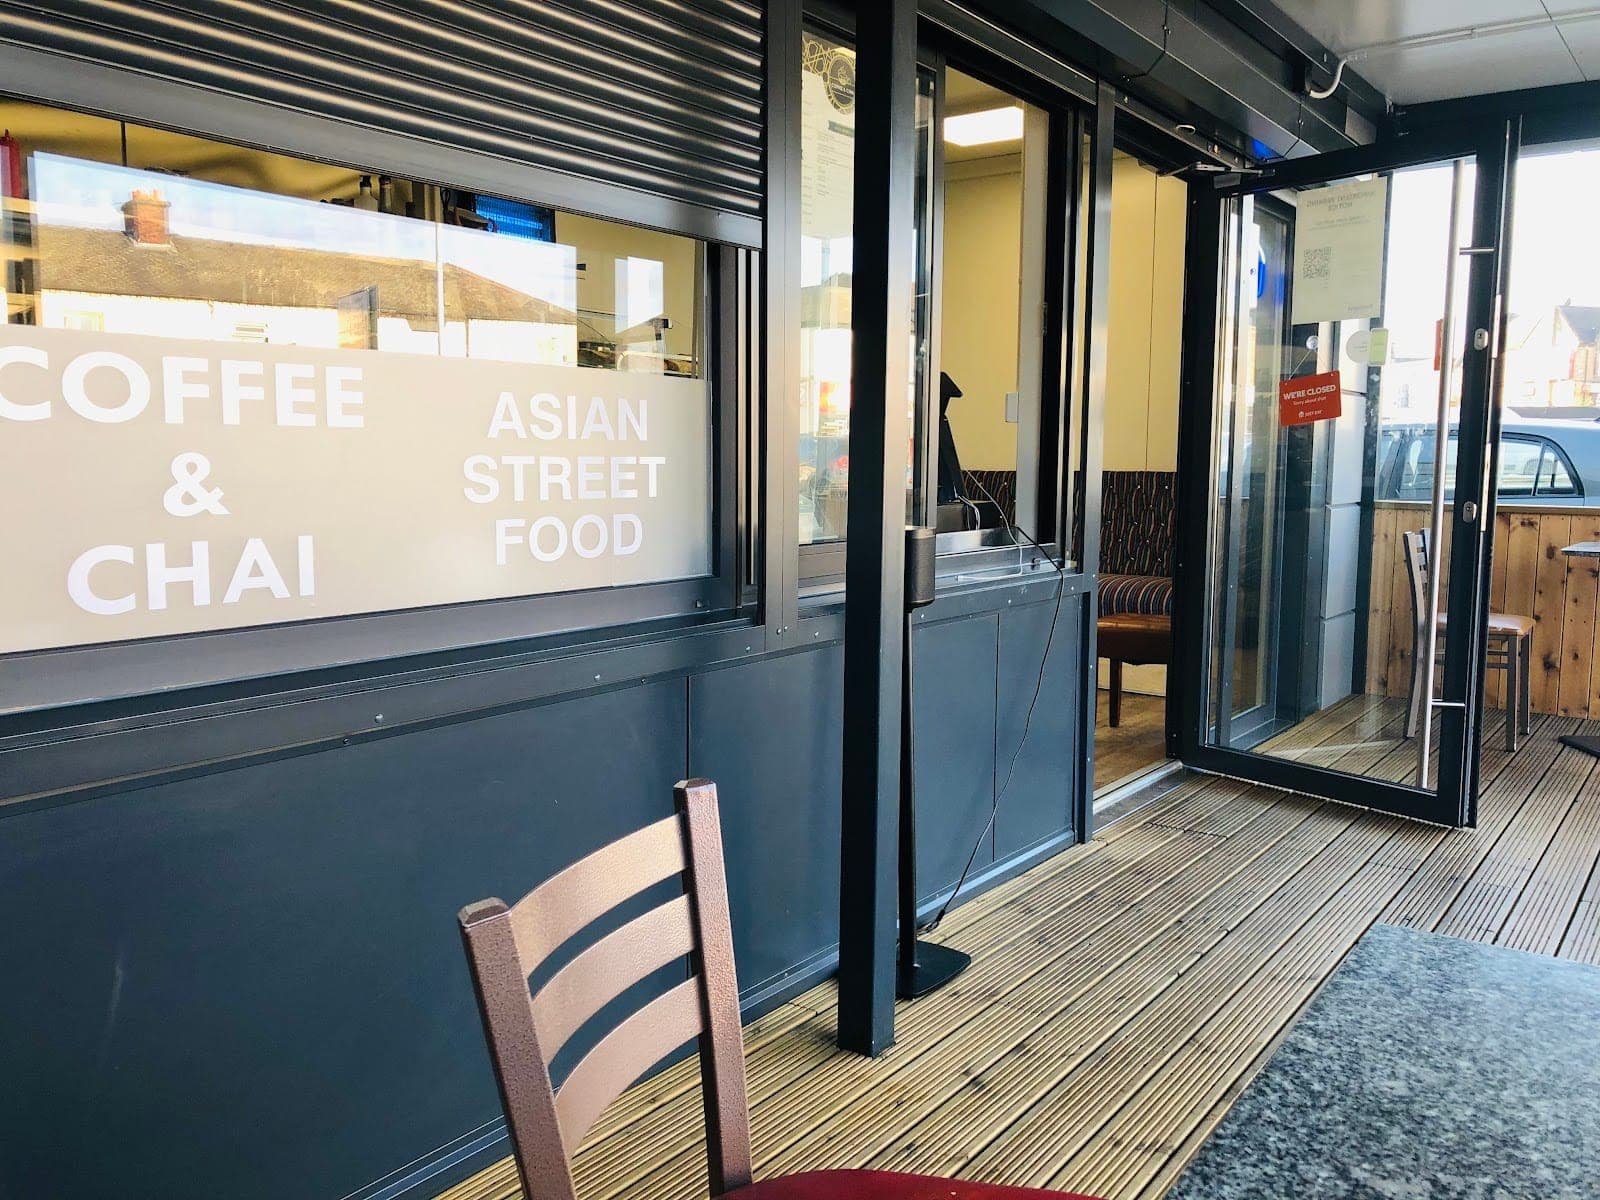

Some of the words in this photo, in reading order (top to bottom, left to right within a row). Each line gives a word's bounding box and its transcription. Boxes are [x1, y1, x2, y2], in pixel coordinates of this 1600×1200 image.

[0, 345, 366, 428] COFFEE
[1306, 385, 1336, 396] CLOSED
[487, 392, 649, 441] ASIAN
[163, 452, 231, 518] &
[463, 456, 667, 503] STREET
[495, 513, 643, 565] FOOD
[67, 535, 315, 615] CHAI
